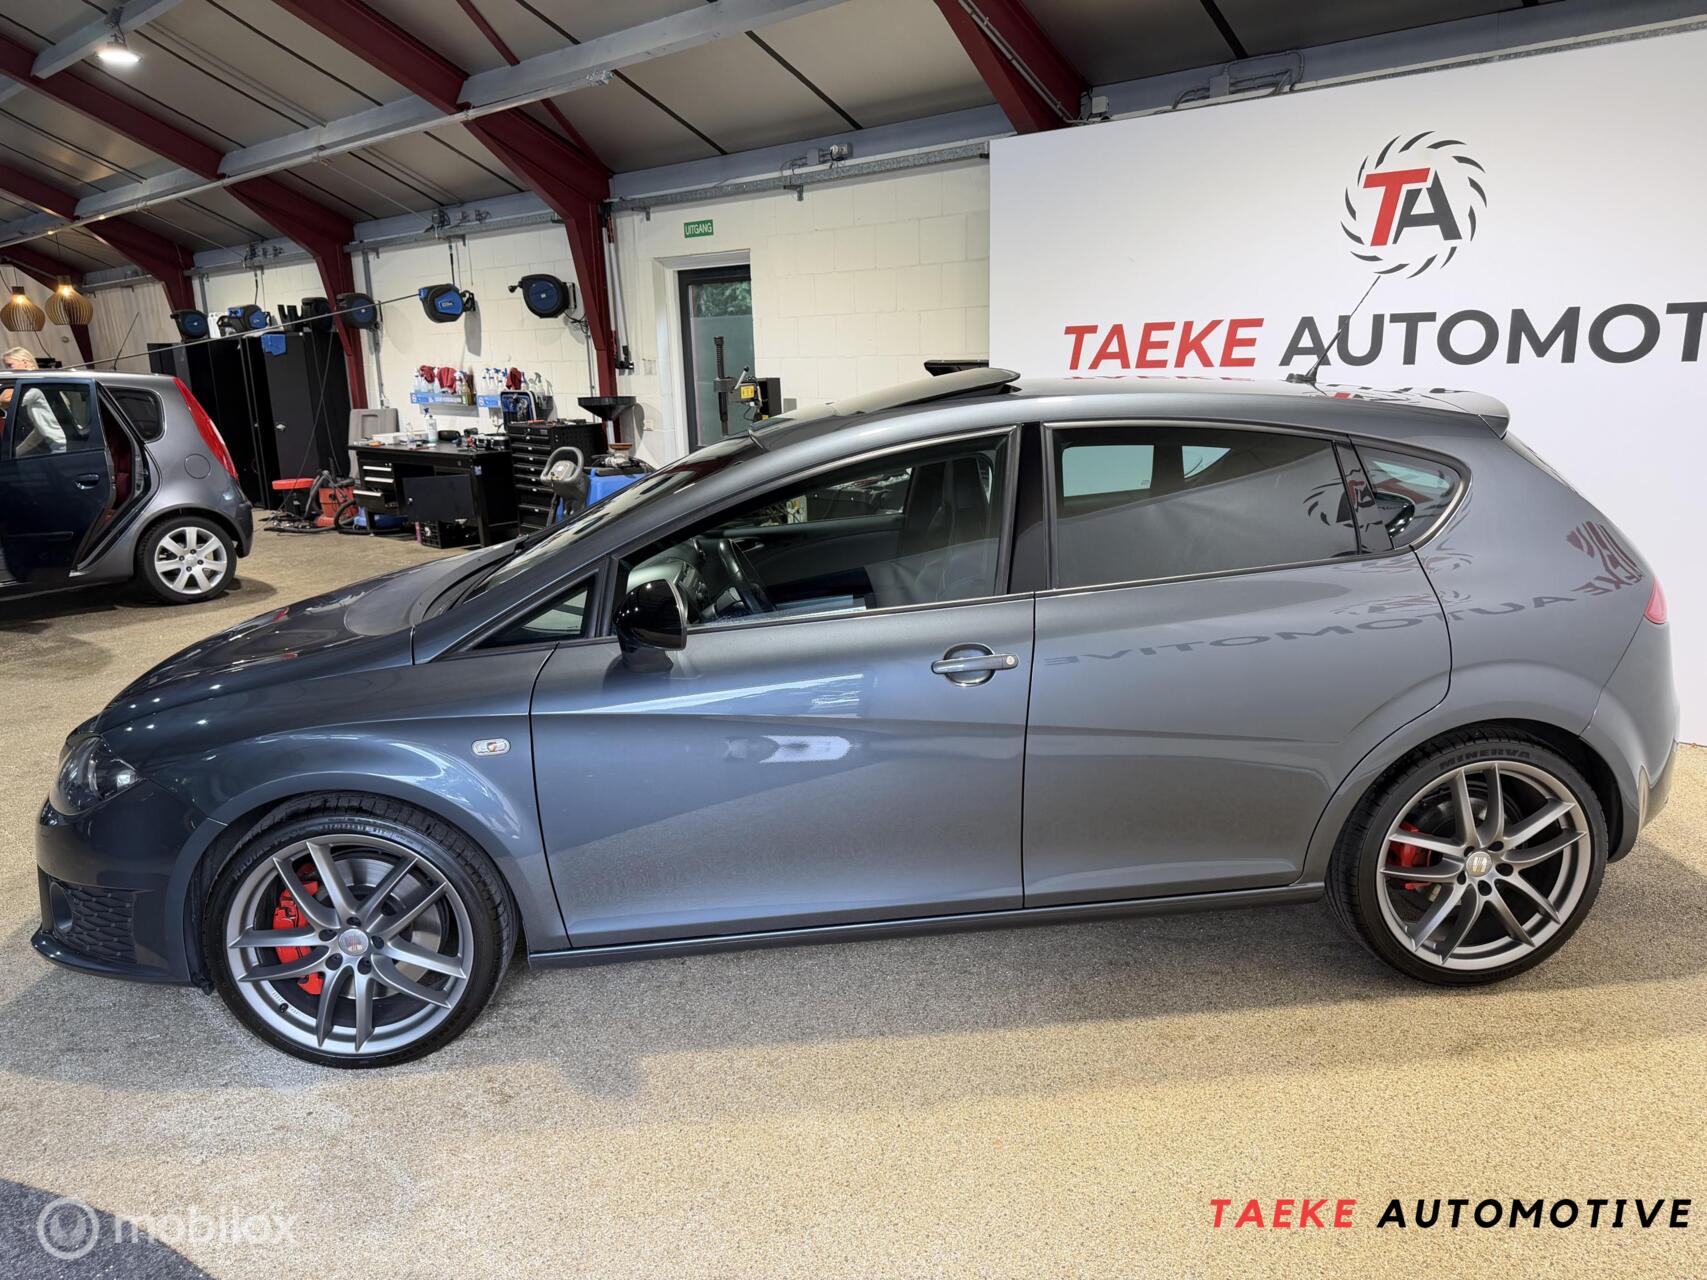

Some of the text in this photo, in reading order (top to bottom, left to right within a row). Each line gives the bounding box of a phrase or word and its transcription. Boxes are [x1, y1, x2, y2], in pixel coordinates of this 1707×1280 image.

[685, 222, 713, 236] UITGANG
[1362, 167, 1462, 247] TA
[1063, 301, 1707, 370] TAEKE AUTOMOT
[1438, 749, 1532, 770] MINERVA
